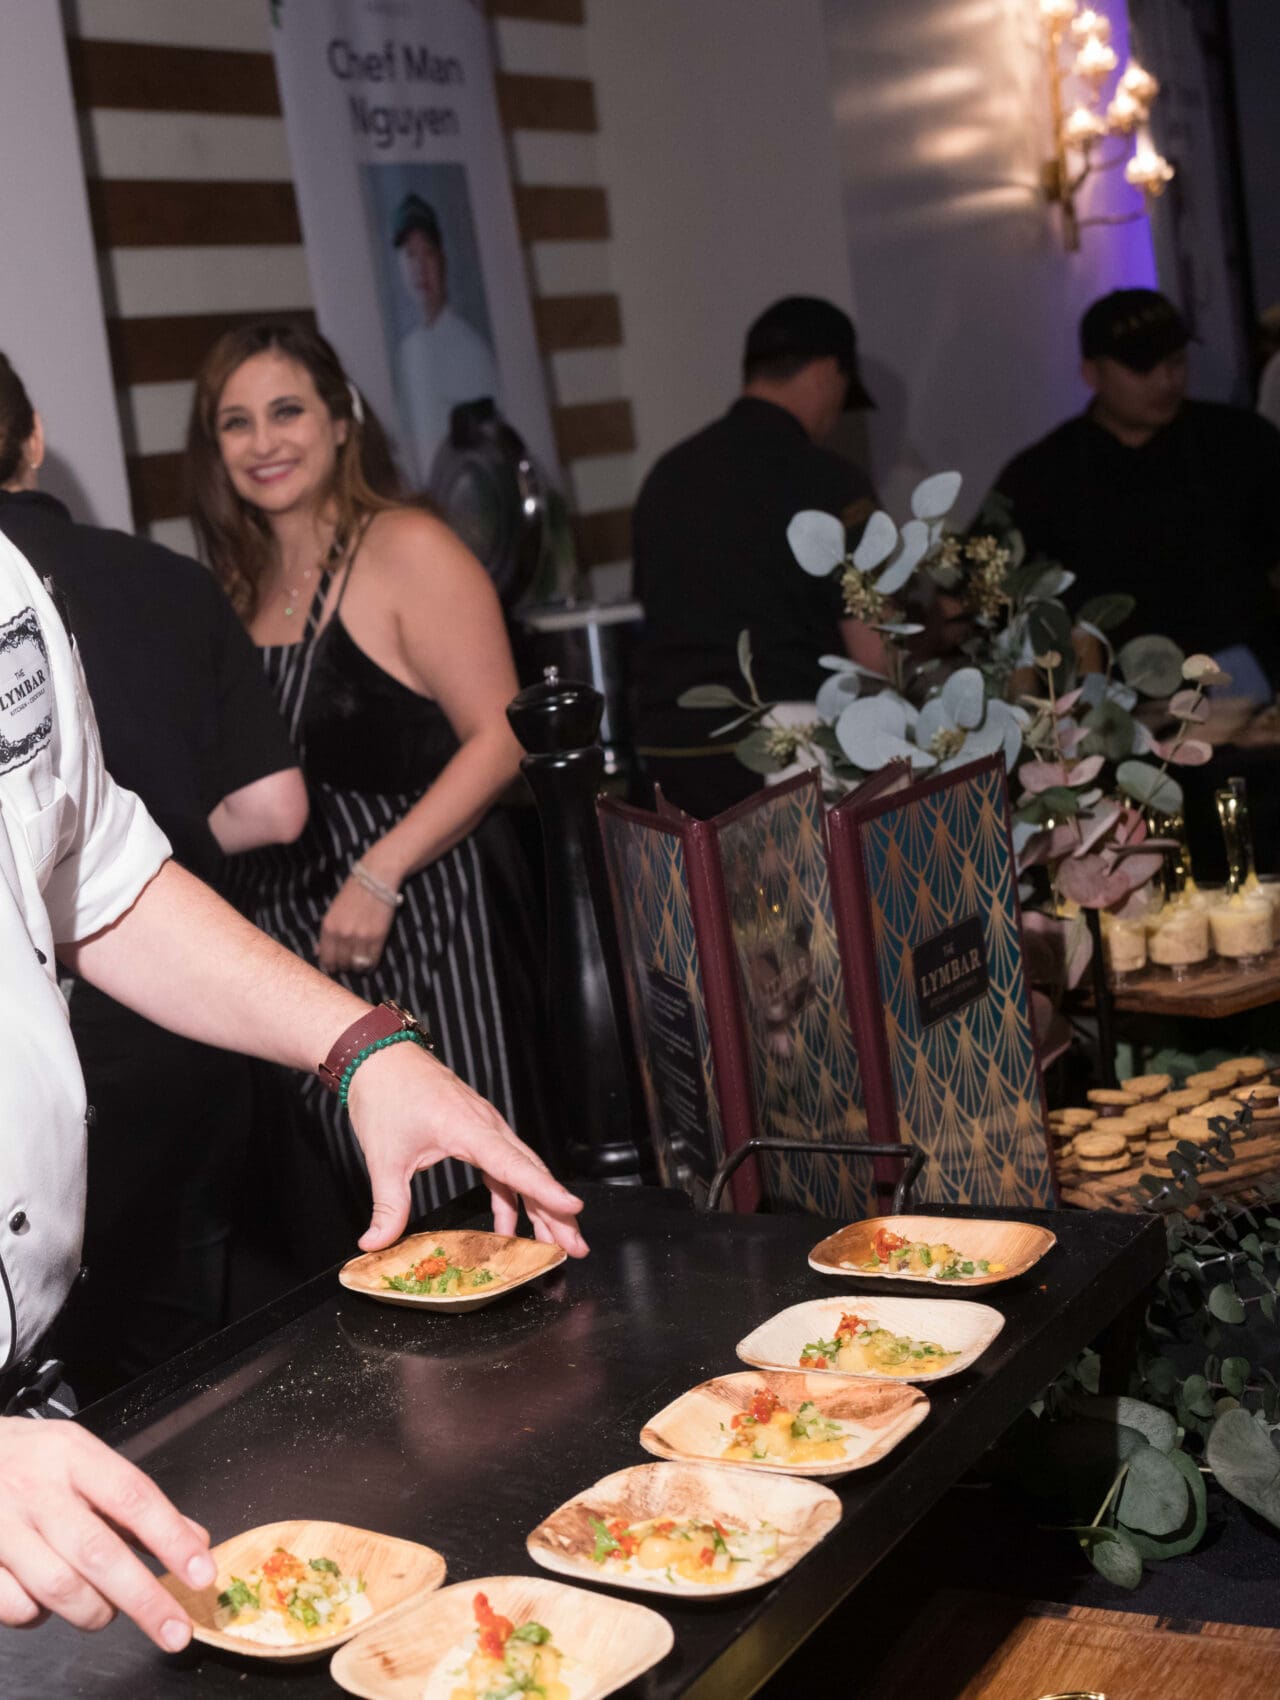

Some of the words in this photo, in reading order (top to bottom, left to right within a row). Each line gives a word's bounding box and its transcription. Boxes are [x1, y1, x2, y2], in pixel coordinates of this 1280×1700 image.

[327, 37, 395, 82] Chef
[402, 46, 465, 84] Man
[350, 96, 460, 149] Nguyen
[14, 668, 25, 680] THE
[920, 947, 982, 997] LYMBAR
